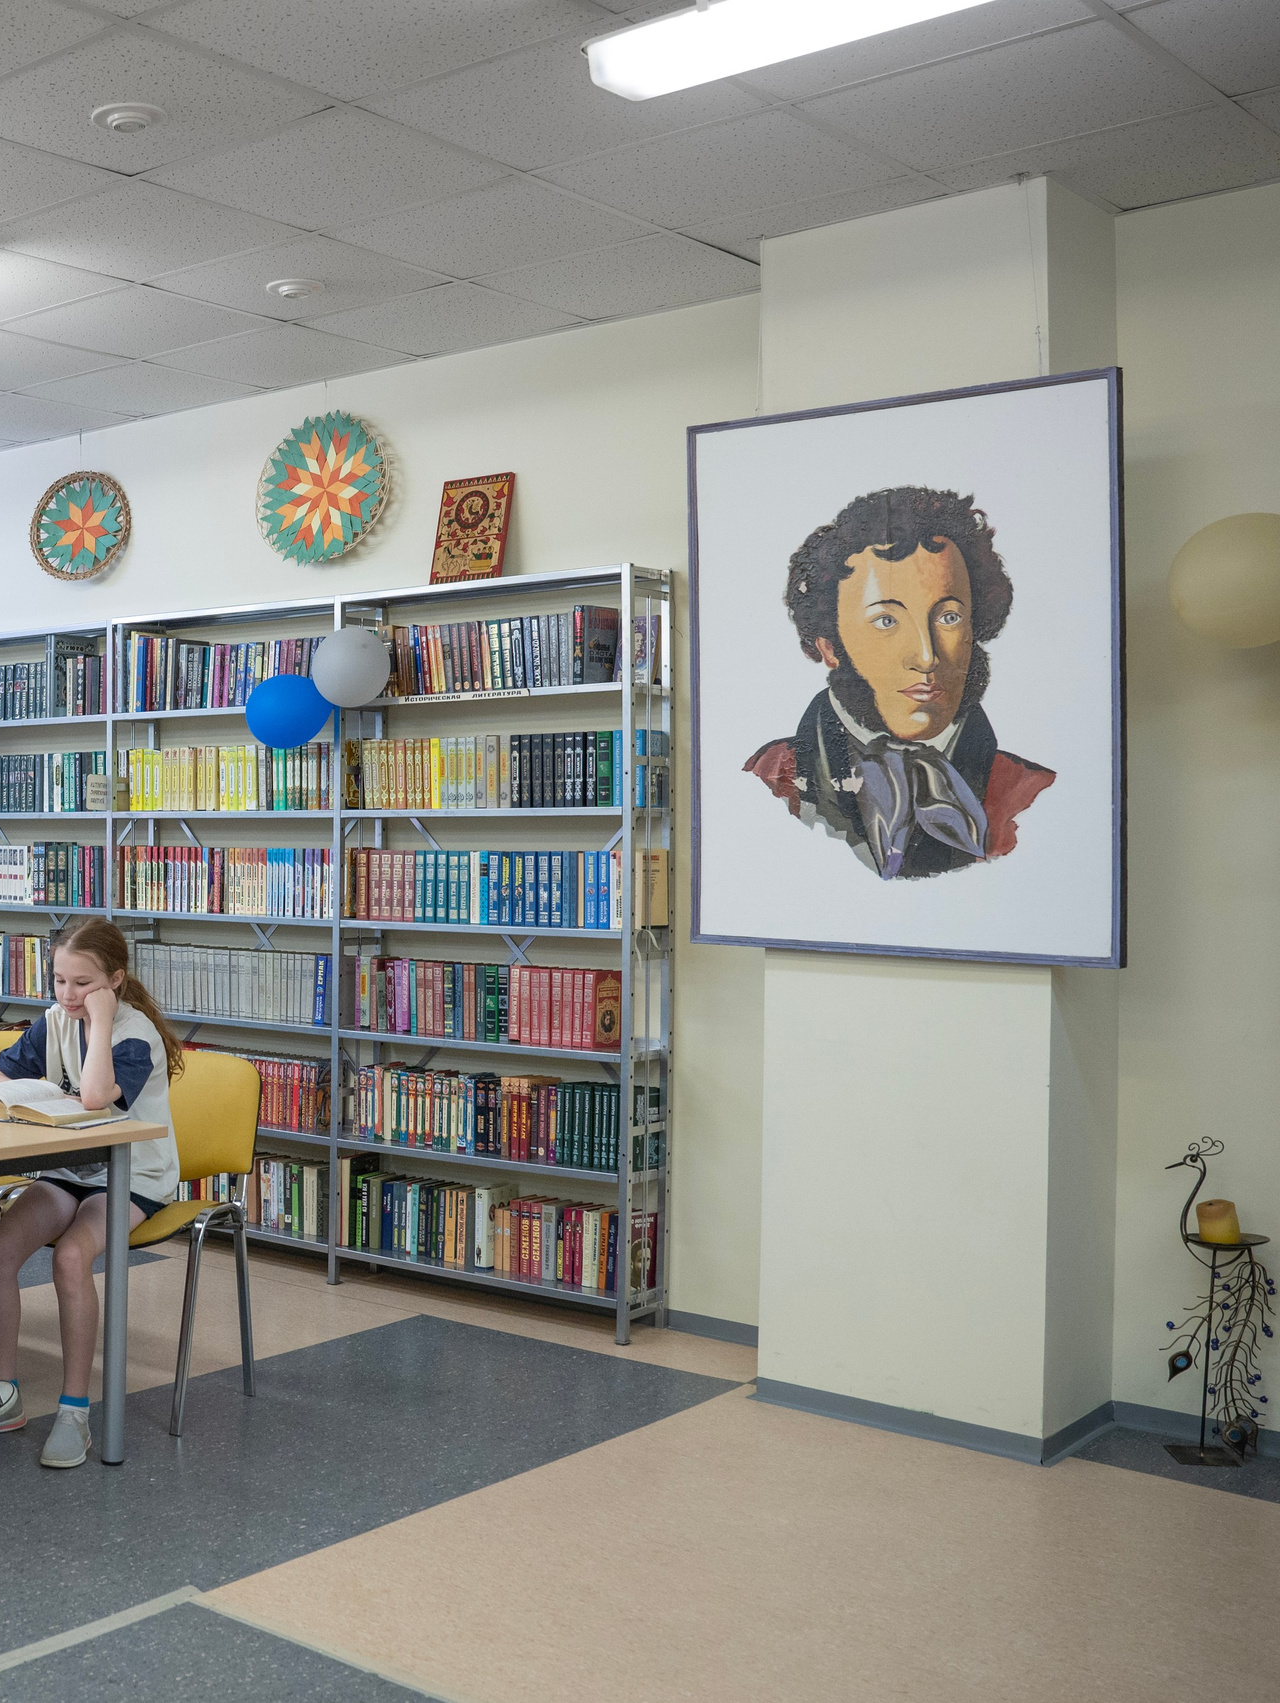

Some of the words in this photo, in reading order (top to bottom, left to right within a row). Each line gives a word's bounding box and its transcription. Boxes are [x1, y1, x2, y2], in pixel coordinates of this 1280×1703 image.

[471, 689, 522, 700] ЛИТЕРАТУРА
[510, 1218, 518, 1257] СЕМЕНОВ
[521, 1219, 530, 1260] СЕМЕНОВ
[531, 1220, 541, 1262] СЕМЕНОВ
